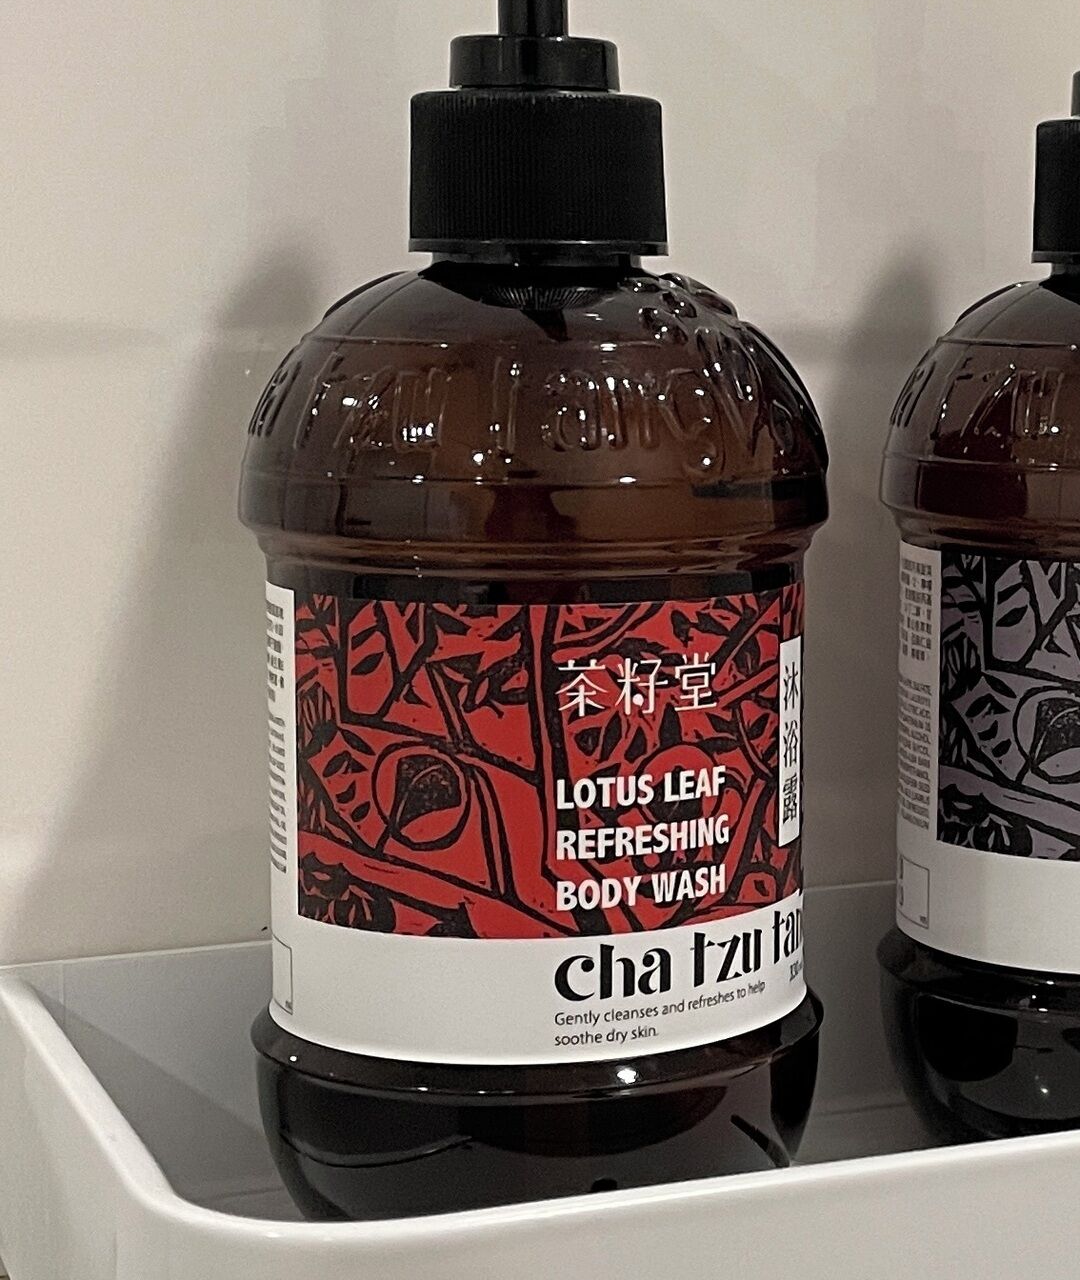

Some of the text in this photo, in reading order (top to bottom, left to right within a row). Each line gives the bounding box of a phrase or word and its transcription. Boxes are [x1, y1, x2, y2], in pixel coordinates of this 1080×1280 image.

[555, 651, 718, 717] 茶籽堂
[782, 661, 800, 824] 沐浴露
[556, 765, 726, 810] LOTUS LEAF
[556, 814, 730, 860] REFRESHING
[556, 863, 726, 911] BODY WASH
[554, 943, 672, 1002] cha
[690, 929, 763, 988] tzu
[554, 980, 766, 1026] Gently cleanses and refreshes to help
[554, 1030, 602, 1046] soothe
[606, 1028, 629, 1044] dry
